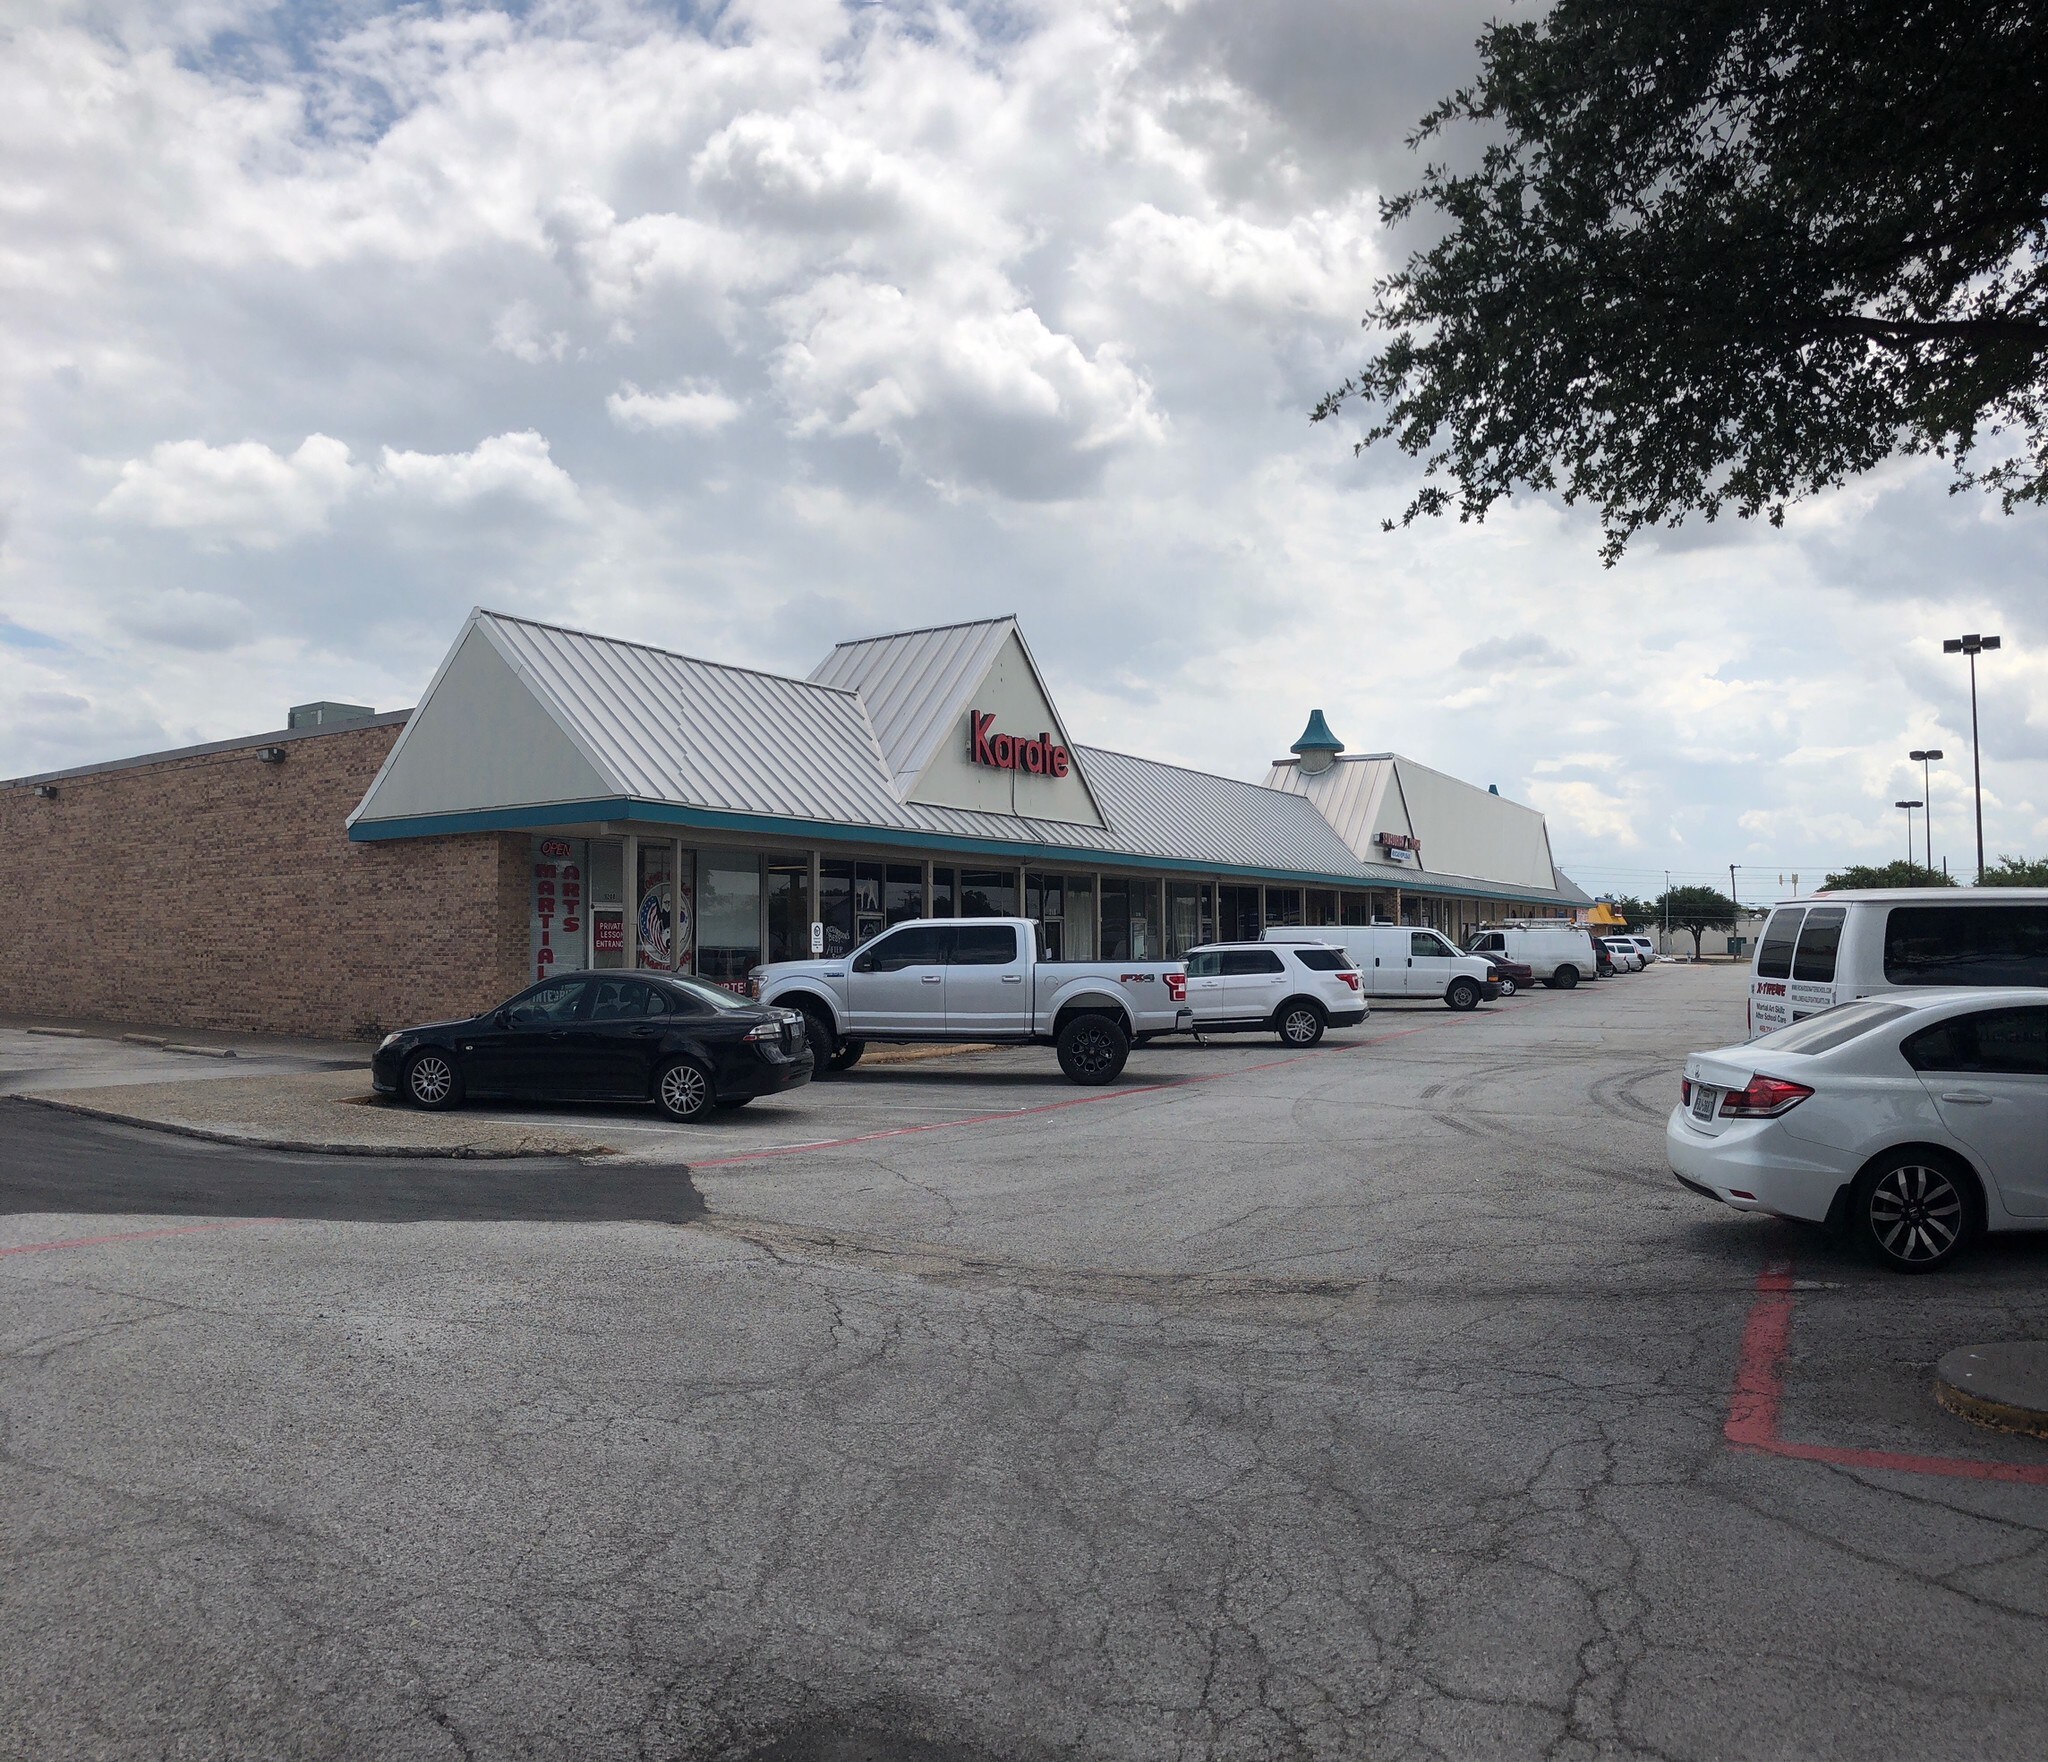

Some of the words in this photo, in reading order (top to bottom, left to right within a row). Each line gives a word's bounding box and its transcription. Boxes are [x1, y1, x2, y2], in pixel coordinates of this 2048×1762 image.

[971, 709, 1069, 779] Karate
[542, 841, 571, 856] OPEN
[563, 866, 580, 932] ARTS
[536, 864, 556, 980] MARTIAL
[596, 940, 624, 948] ENTRANC
[1120, 973, 1155, 983] FX4
[1755, 1011, 1764, 1020] After
[1764, 1012, 1777, 1022] School
[1777, 1014, 1787, 1024] Care
